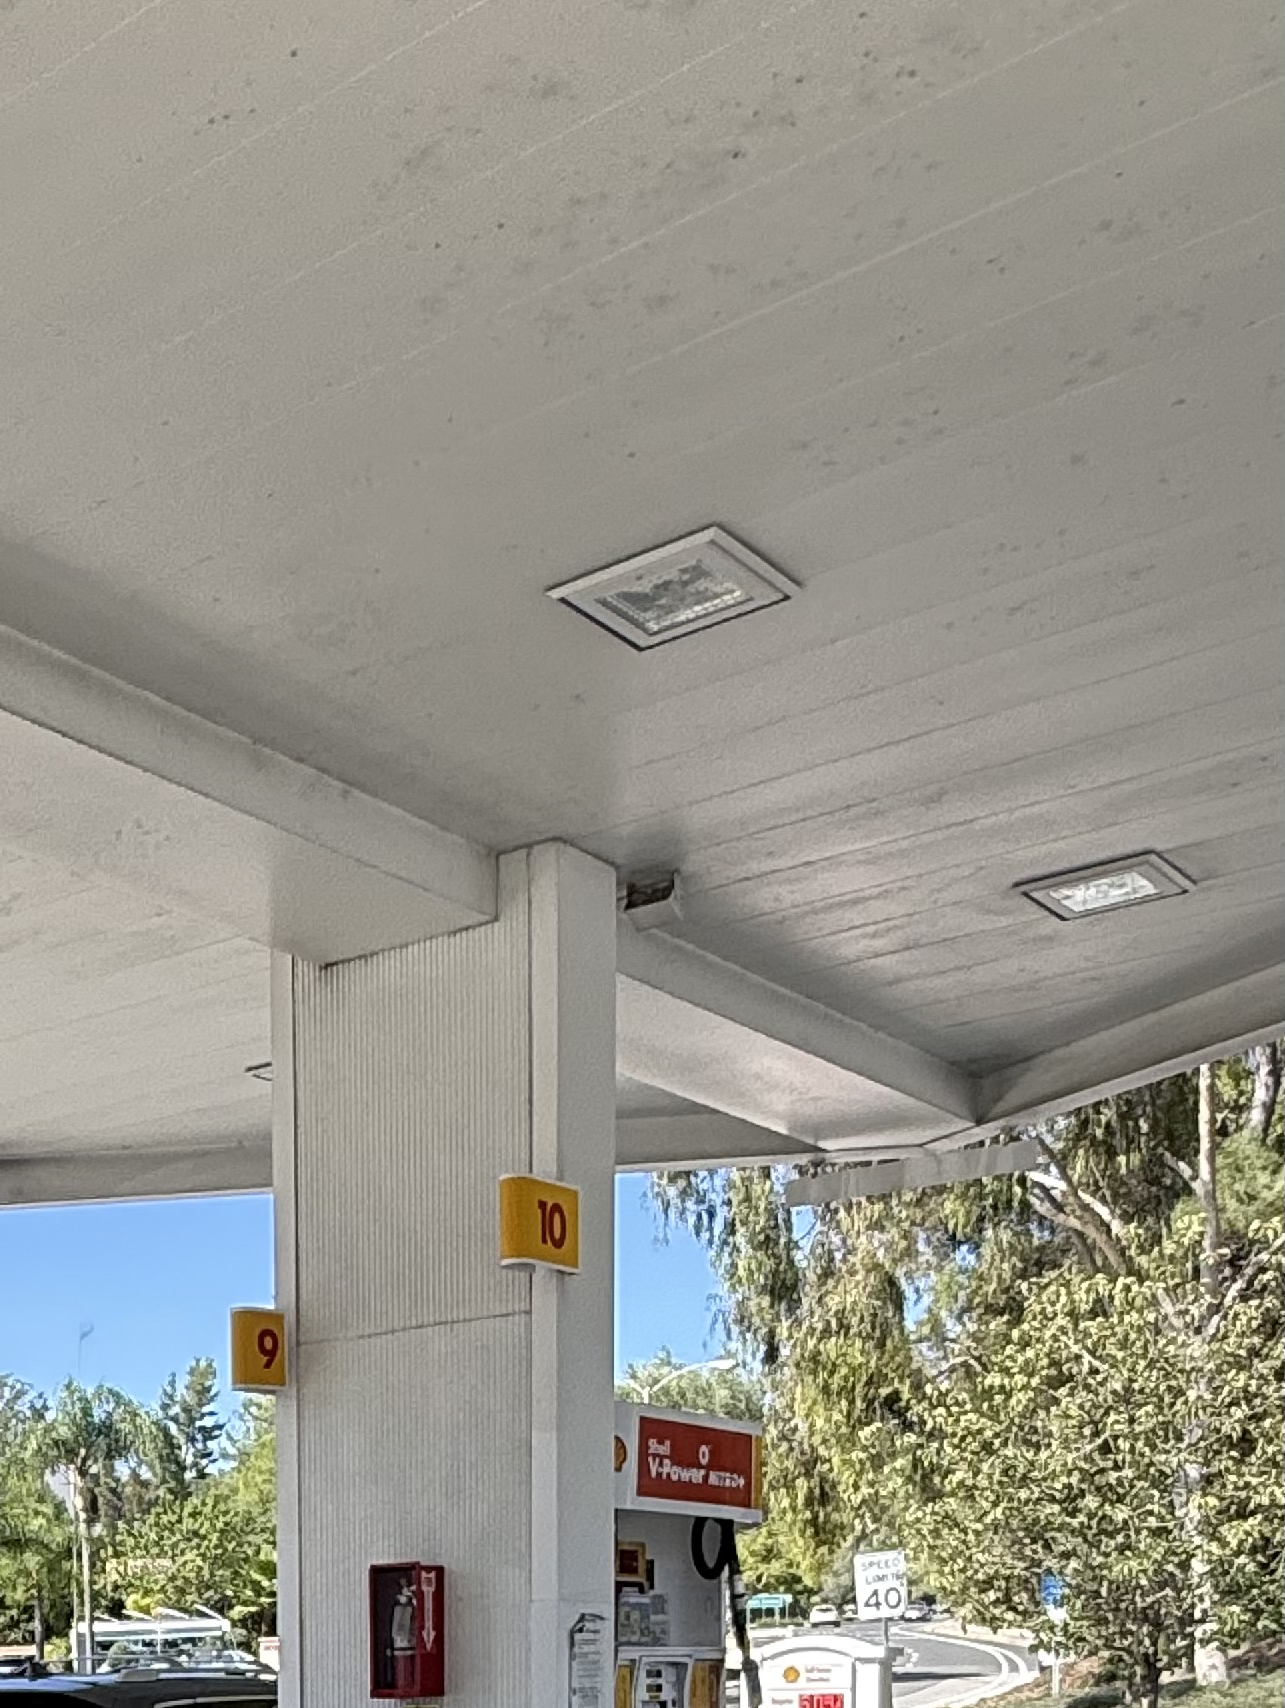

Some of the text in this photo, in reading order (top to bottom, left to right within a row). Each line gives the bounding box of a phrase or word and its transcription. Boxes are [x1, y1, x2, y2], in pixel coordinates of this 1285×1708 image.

[537, 1198, 567, 1250] 10
[257, 1327, 279, 1370] 9
[647, 1455, 707, 1485] V-Power
[861, 1557, 901, 1572] SPEED
[865, 1572, 898, 1586] LIMIT
[863, 1586, 902, 1611] 40
